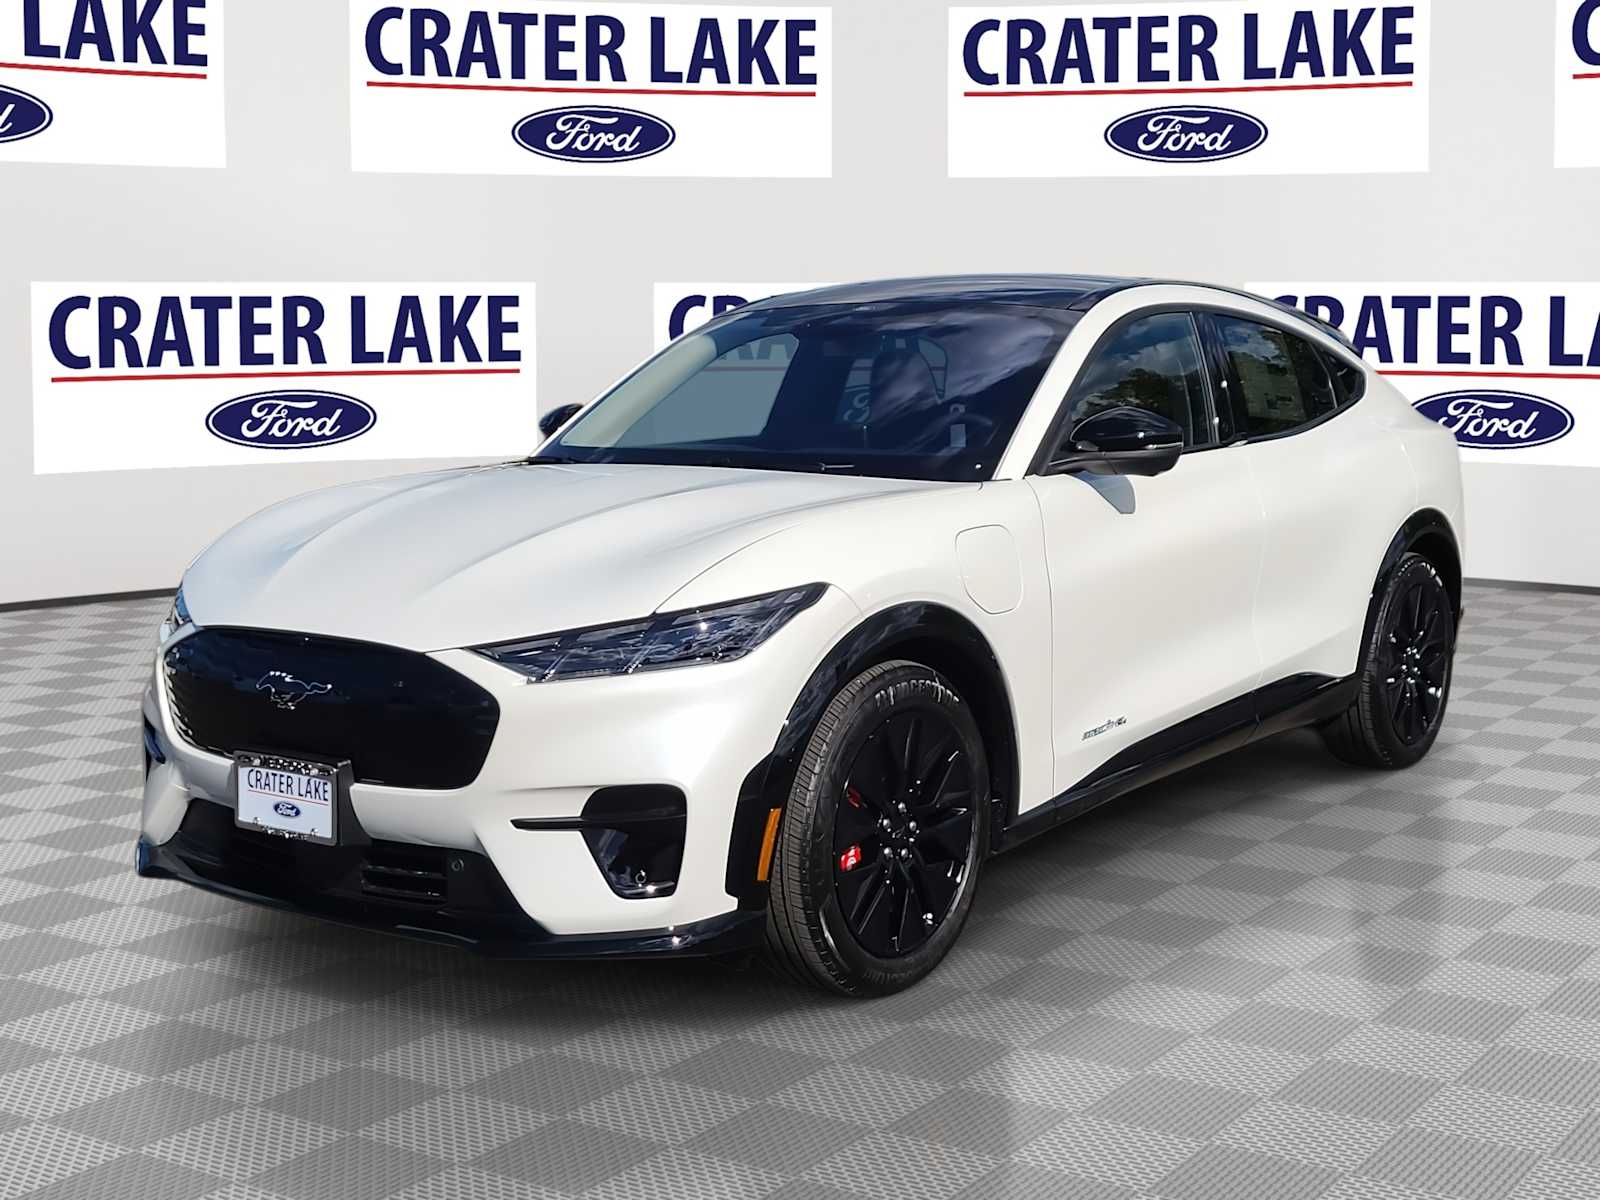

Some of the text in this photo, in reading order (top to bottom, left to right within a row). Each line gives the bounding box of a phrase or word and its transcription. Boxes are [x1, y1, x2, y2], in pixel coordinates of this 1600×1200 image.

[23, 0, 207, 66] LAKE
[365, 7, 817, 86] CRATER LAKE
[963, 6, 1414, 86] CRATER LAKE
[546, 115, 642, 152] Ford
[1137, 115, 1233, 152] Ford
[49, 296, 521, 370] CRATER LAKE
[241, 400, 342, 438] Ford
[1438, 398, 1539, 438] Ford
[248, 769, 328, 801] CRATER LAKE
